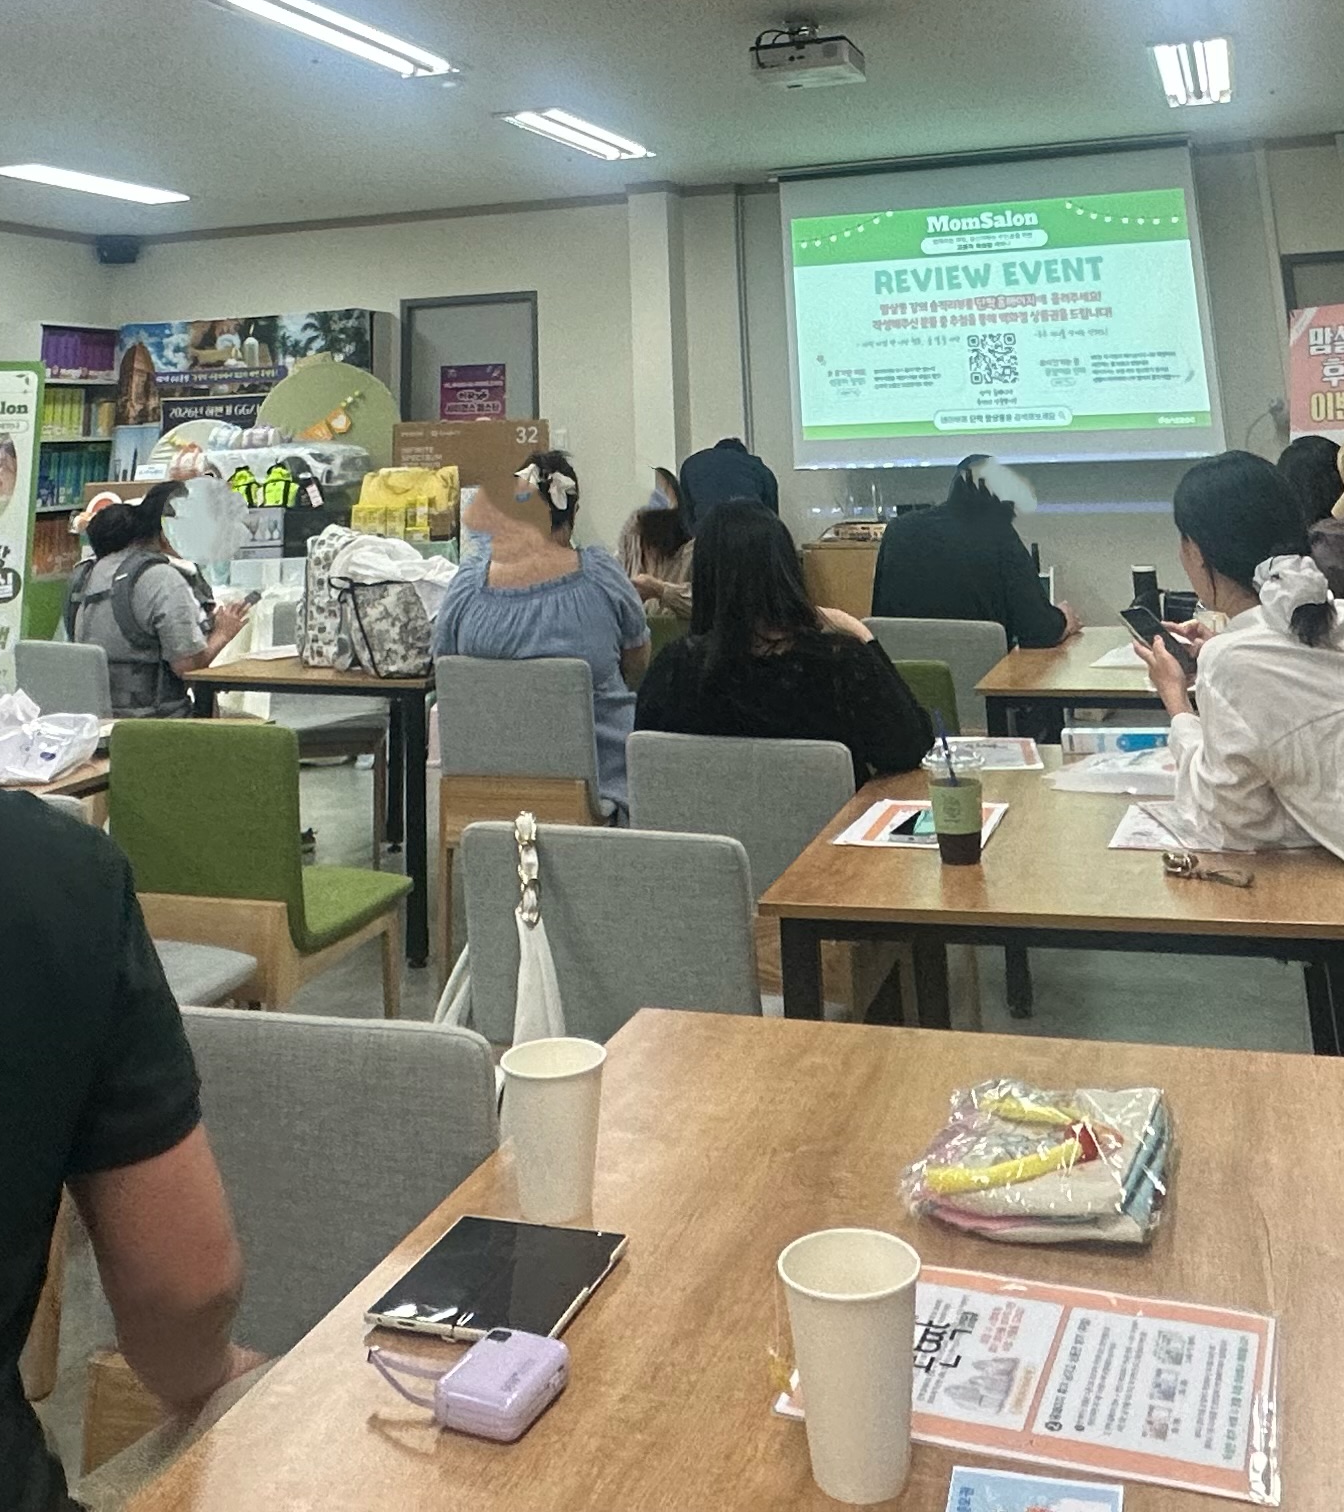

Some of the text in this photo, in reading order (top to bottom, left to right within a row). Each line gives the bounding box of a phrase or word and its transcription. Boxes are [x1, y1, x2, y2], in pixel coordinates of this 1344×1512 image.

[926, 210, 1038, 233] MomSalon
[874, 256, 1103, 294] REVIEW EVENT
[515, 426, 539, 444] 32
